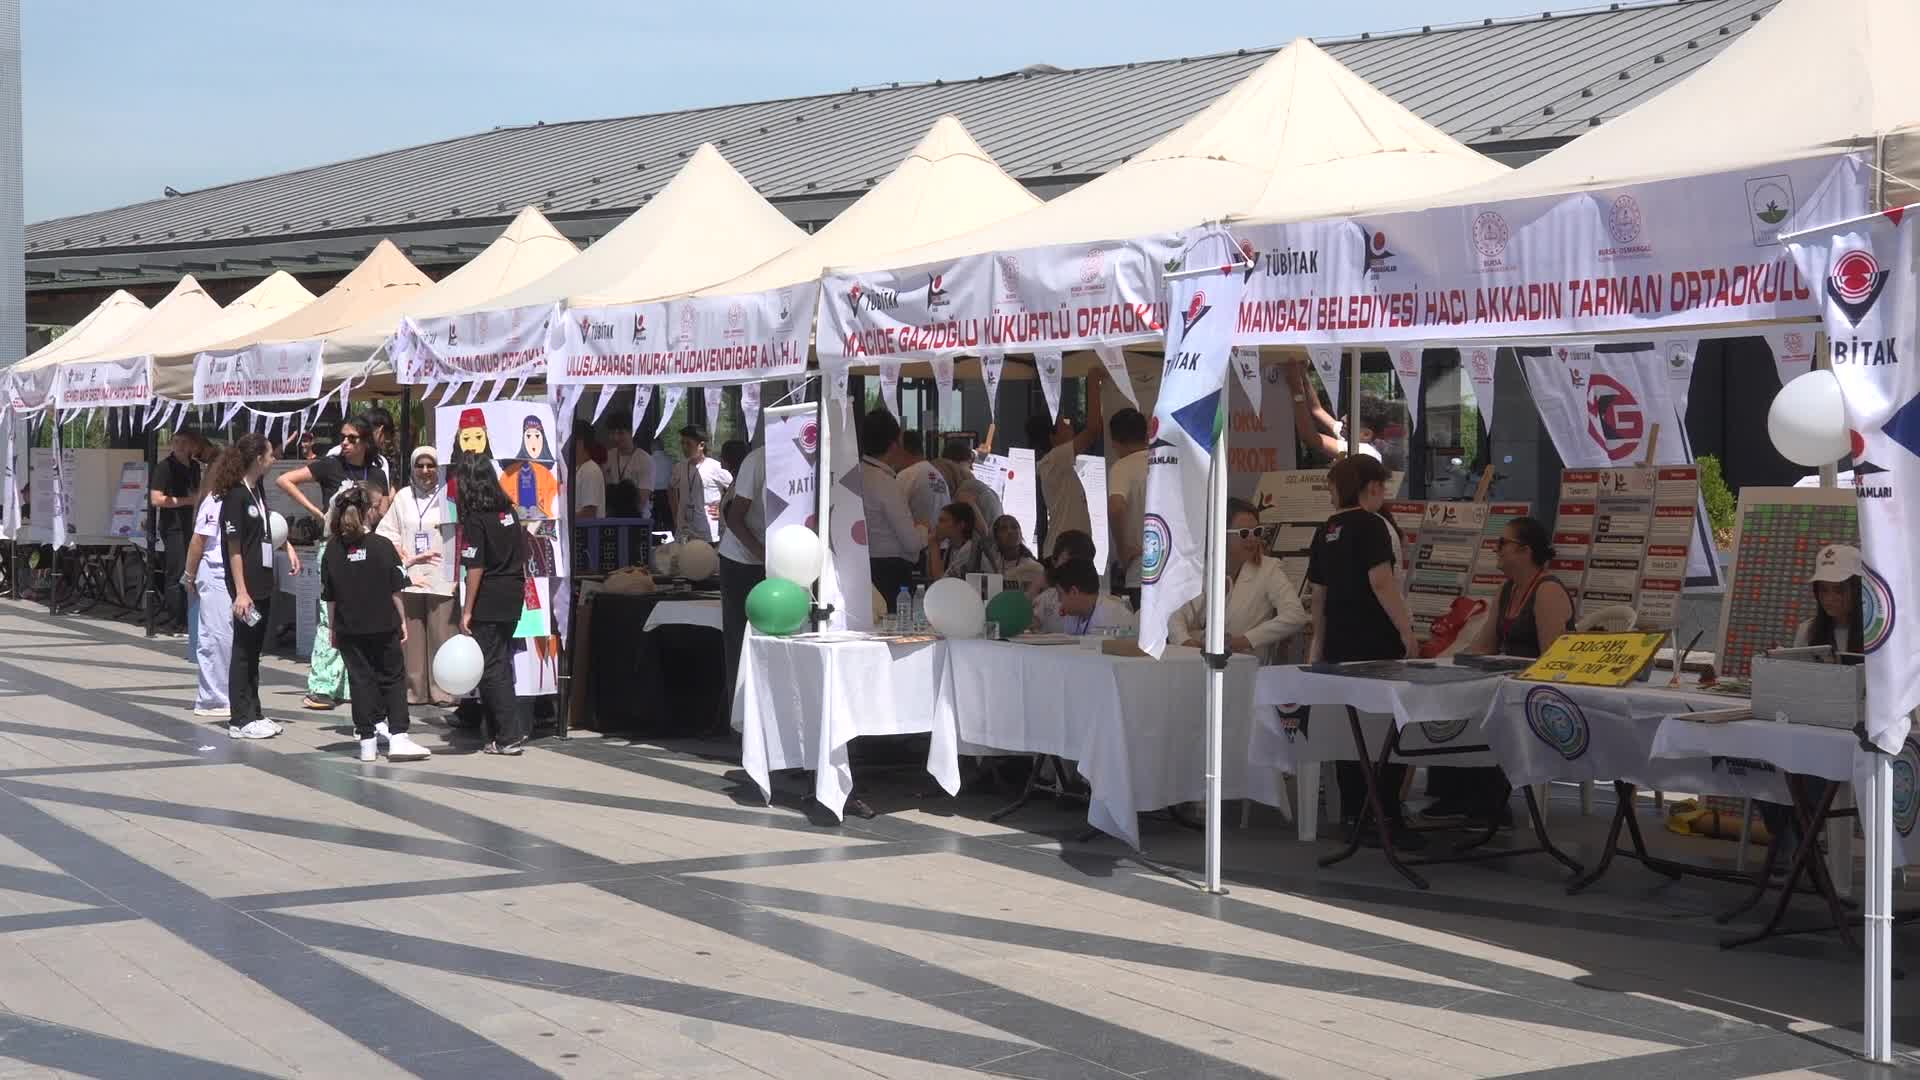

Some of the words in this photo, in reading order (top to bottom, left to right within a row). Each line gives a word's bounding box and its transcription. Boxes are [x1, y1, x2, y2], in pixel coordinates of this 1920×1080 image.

[1265, 247, 1318, 276] TÜBİTAK
[866, 288, 901, 312] TÜBİTAK
[1237, 289, 1313, 333] MANGAZİ
[1316, 283, 1418, 330] BELEDİYESİ
[1424, 288, 1468, 326] HACI
[1475, 281, 1562, 323] AKKADIN
[1569, 273, 1662, 318] TARMAN
[1670, 260, 1810, 310] ORTAOKULU
[591, 320, 614, 340] TÜBİTAK
[843, 325, 895, 358] MACİDE
[899, 313, 978, 352] GAZİOĞLU
[984, 303, 1071, 344] KÜKÜRTLÜ
[567, 352, 635, 376] ULUSLARARASI
[638, 351, 673, 375] MURAT
[675, 341, 757, 373] HÜDAVENDİGAR
[1827, 336, 1898, 366] BİTAK
